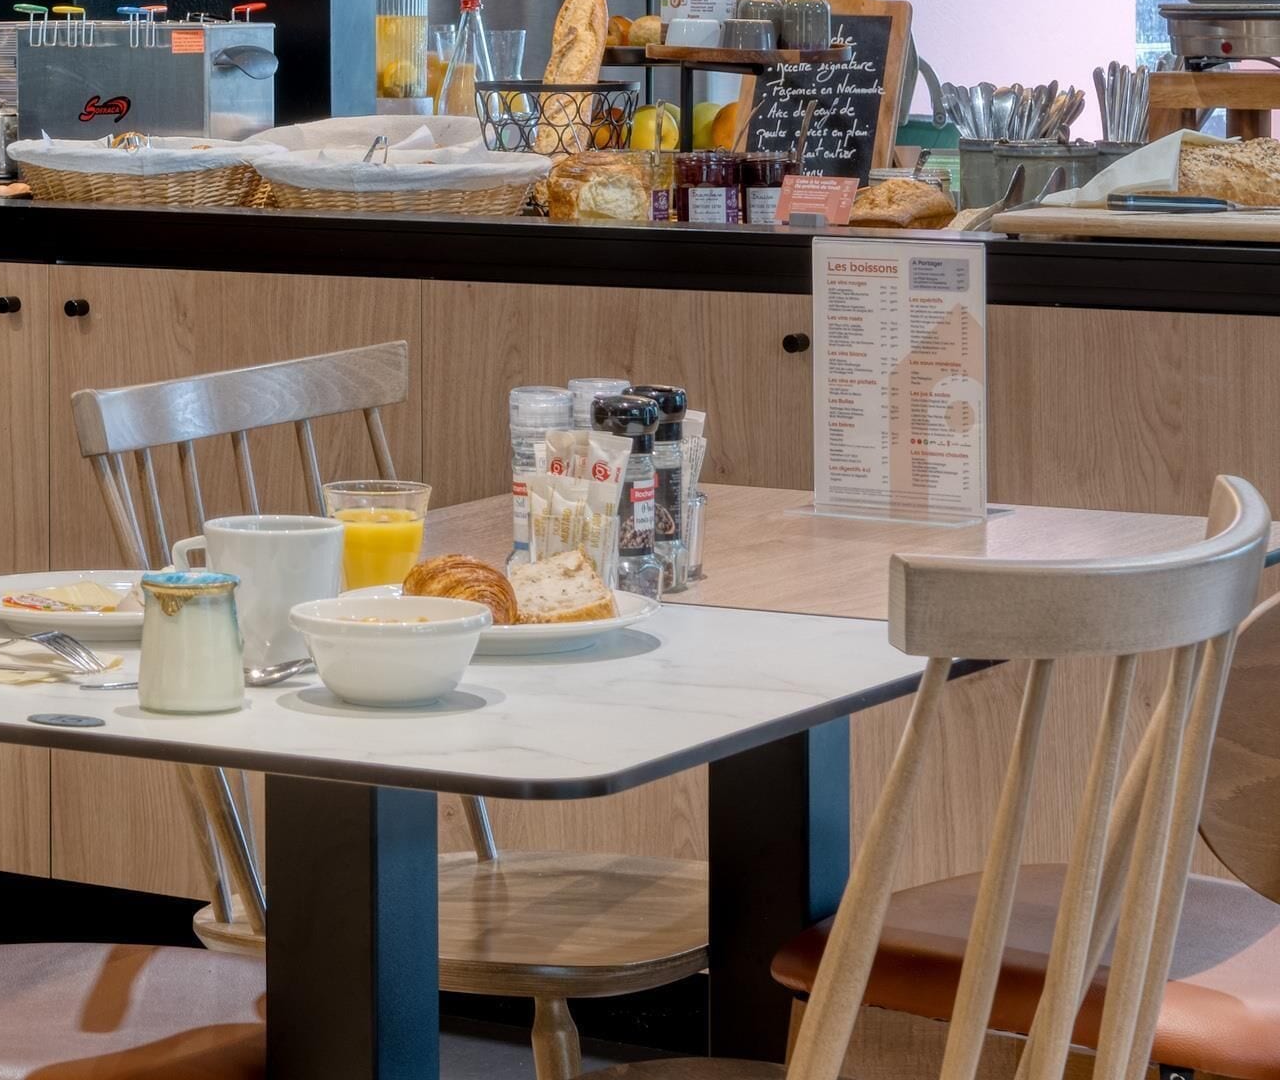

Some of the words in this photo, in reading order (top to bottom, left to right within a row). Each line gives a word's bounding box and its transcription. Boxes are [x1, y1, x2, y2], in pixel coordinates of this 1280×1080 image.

[816, 52, 876, 82] signature
[820, 86, 833, 96] en
[840, 97, 856, 117] de
[827, 261, 847, 273] Les
[850, 261, 898, 274] boissons
